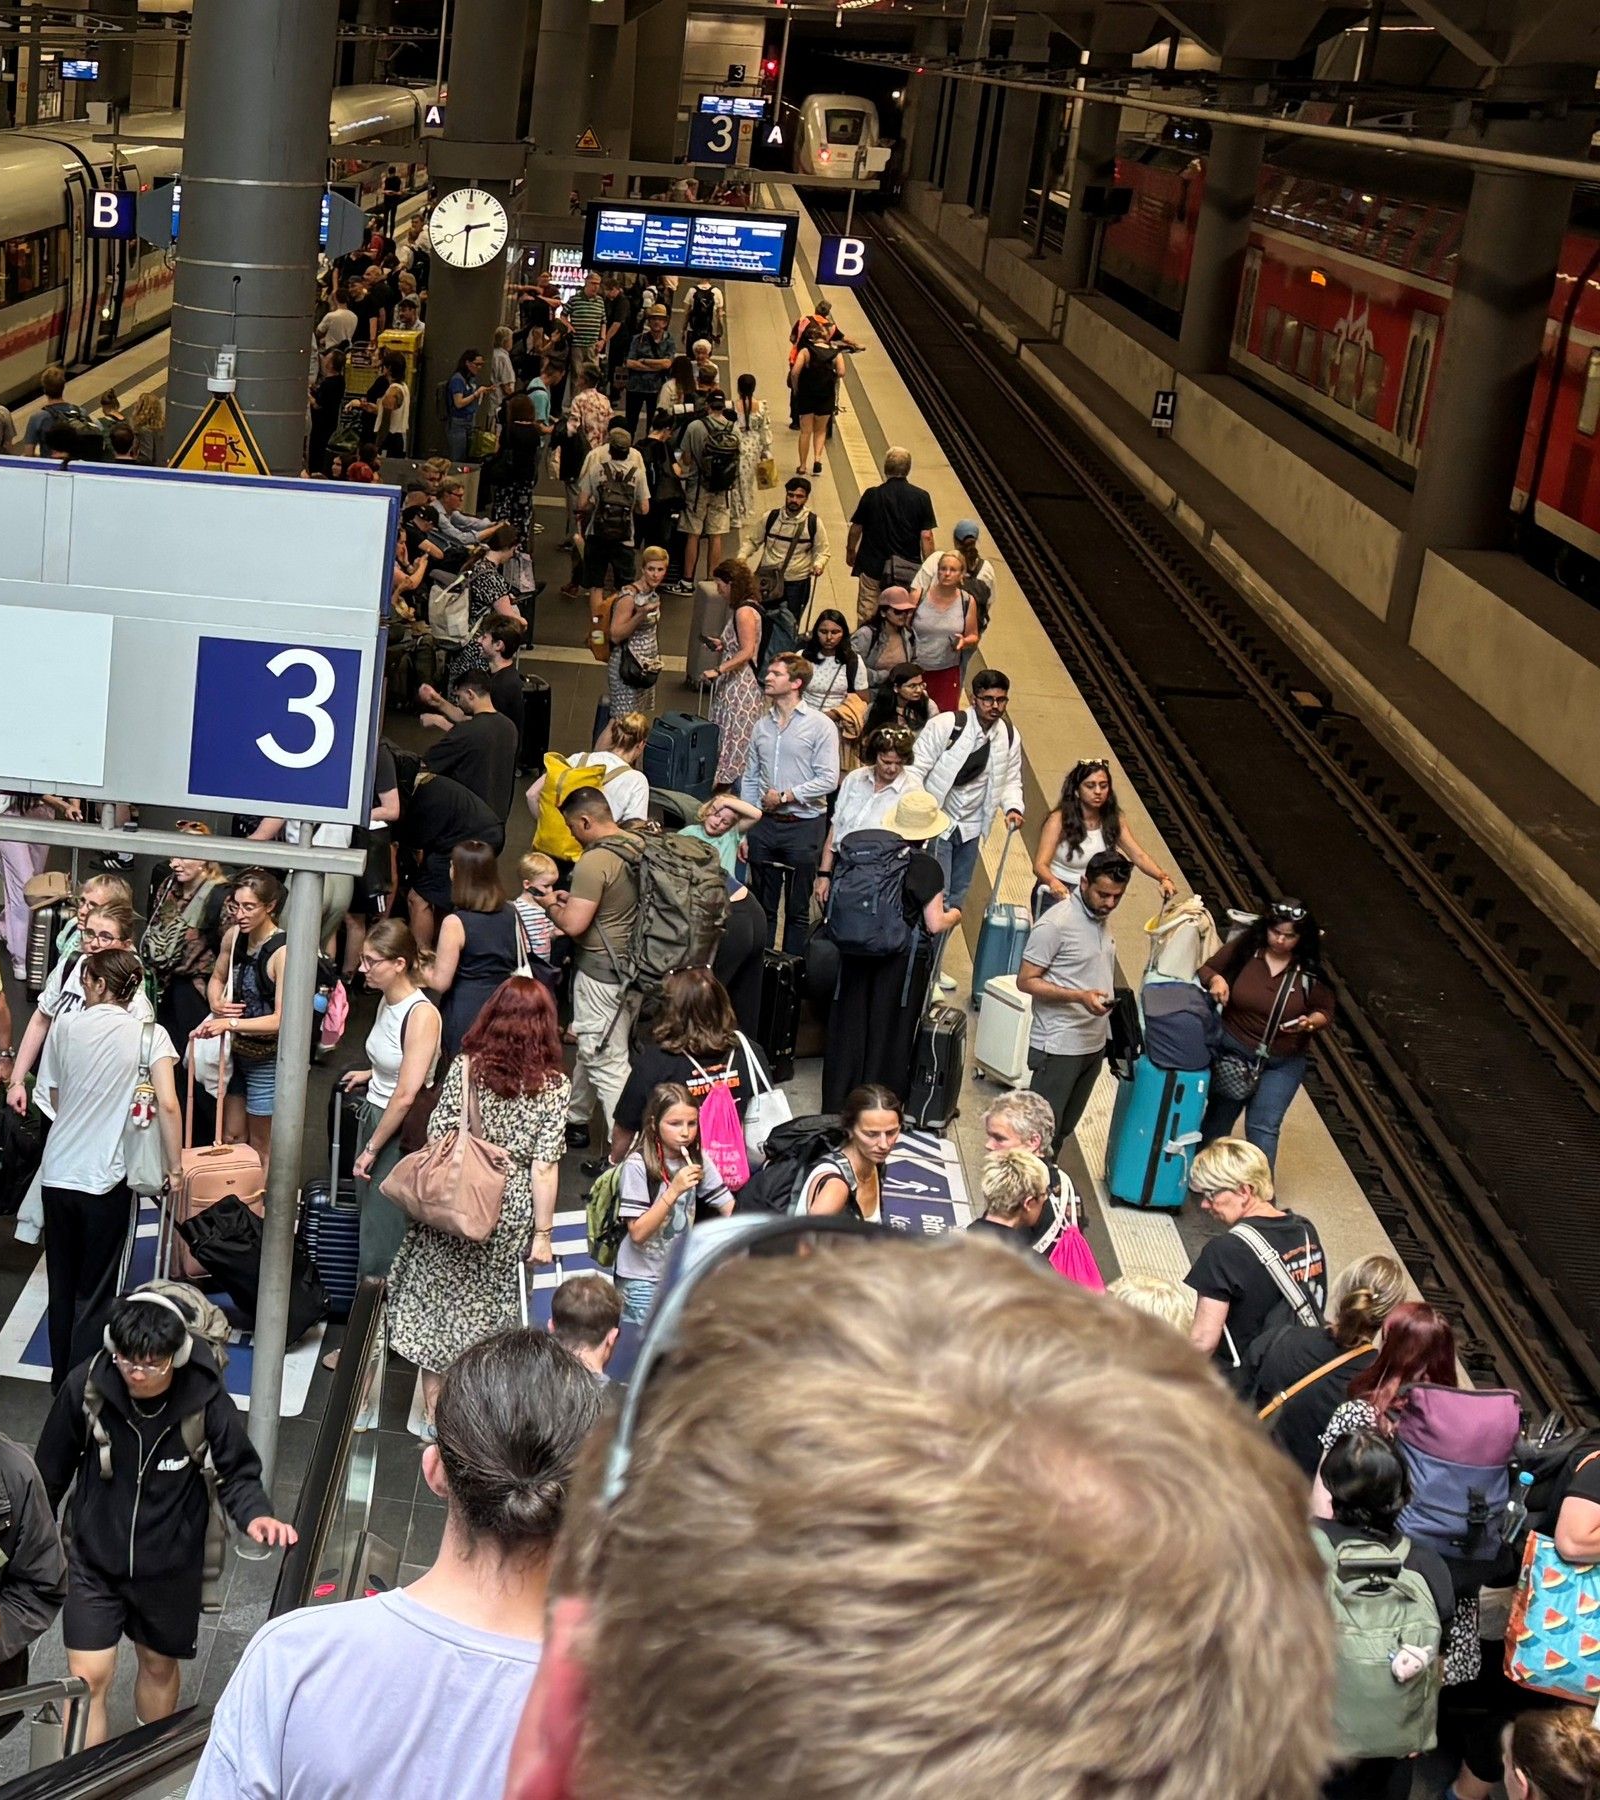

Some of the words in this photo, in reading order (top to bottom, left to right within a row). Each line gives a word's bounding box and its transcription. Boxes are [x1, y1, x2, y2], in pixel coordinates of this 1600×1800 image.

[734, 66, 744, 79] 3
[425, 106, 441, 124] A
[707, 114, 733, 153] 3
[767, 125, 783, 144] A
[93, 191, 119, 229] B
[835, 238, 865, 276] B
[1156, 394, 1173, 415] H
[255, 648, 336, 769] 3
